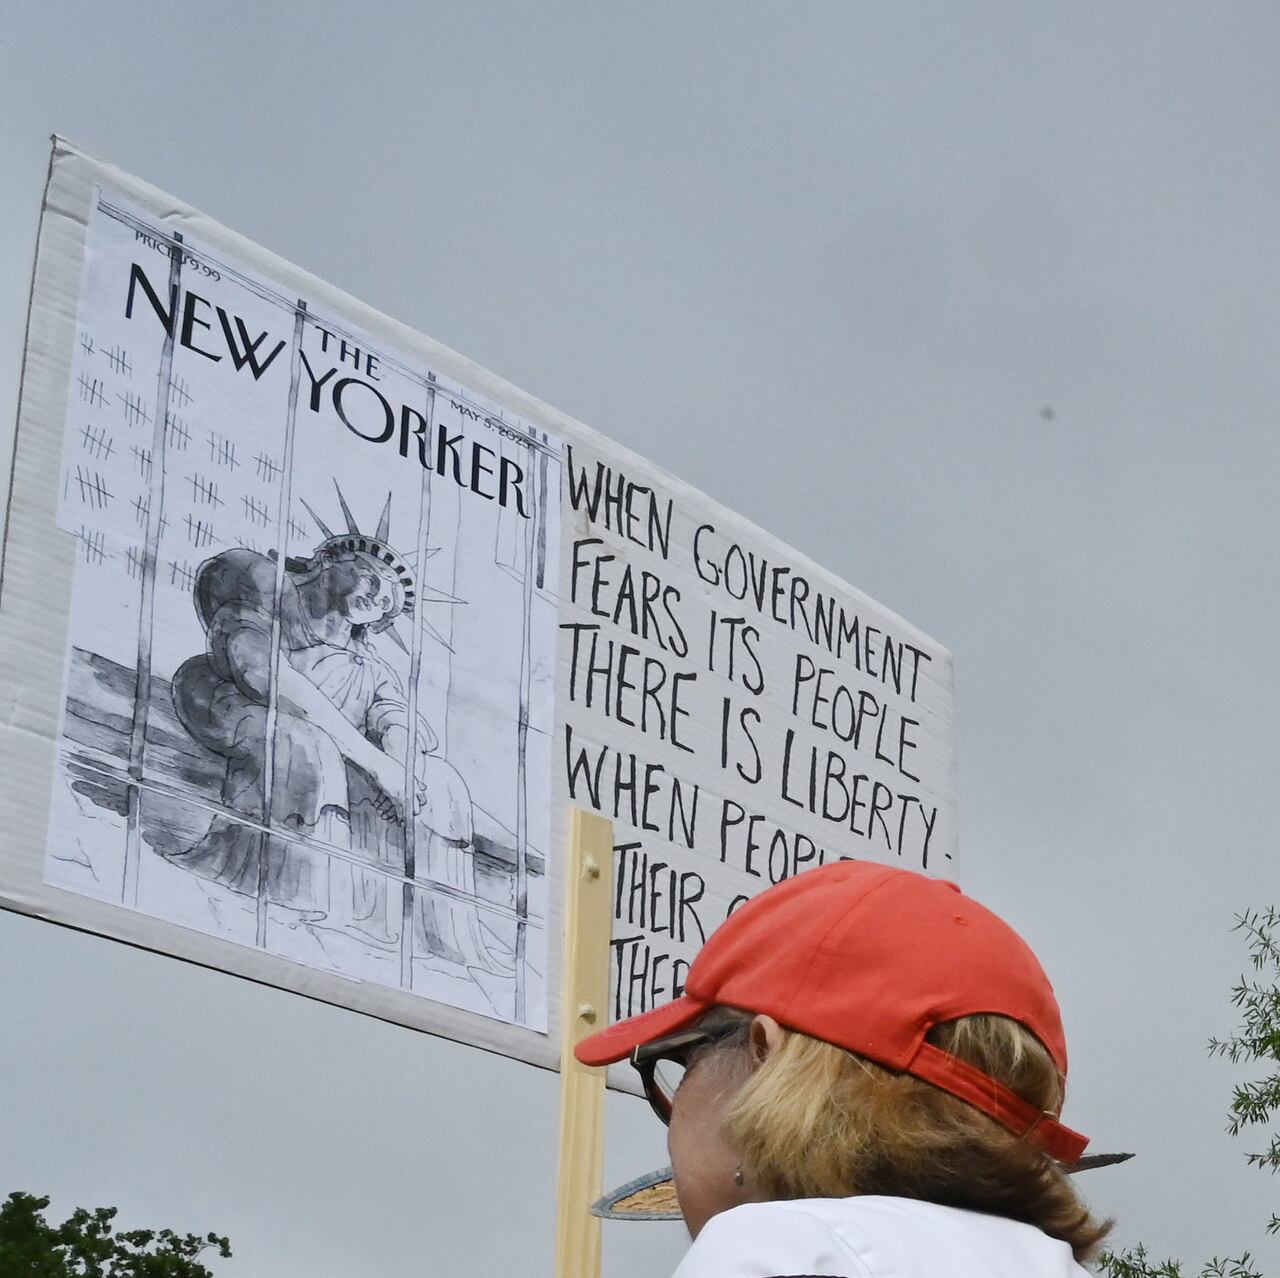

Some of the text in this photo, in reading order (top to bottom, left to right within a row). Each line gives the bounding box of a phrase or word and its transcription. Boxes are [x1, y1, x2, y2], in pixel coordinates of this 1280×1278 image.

[125, 262, 287, 382] NEW
[315, 326, 381, 382] THE
[298, 348, 533, 520] YORKER
[450, 399, 480, 421] MAY
[566, 444, 932, 703] WHEN GOVERNMENT
[571, 538, 921, 782] FEARS ITS PEOPLE
[559, 623, 953, 869] THERE IS LIBERTY.
[565, 724, 854, 886] WHEN PEOP
[612, 842, 706, 945] THEIR
